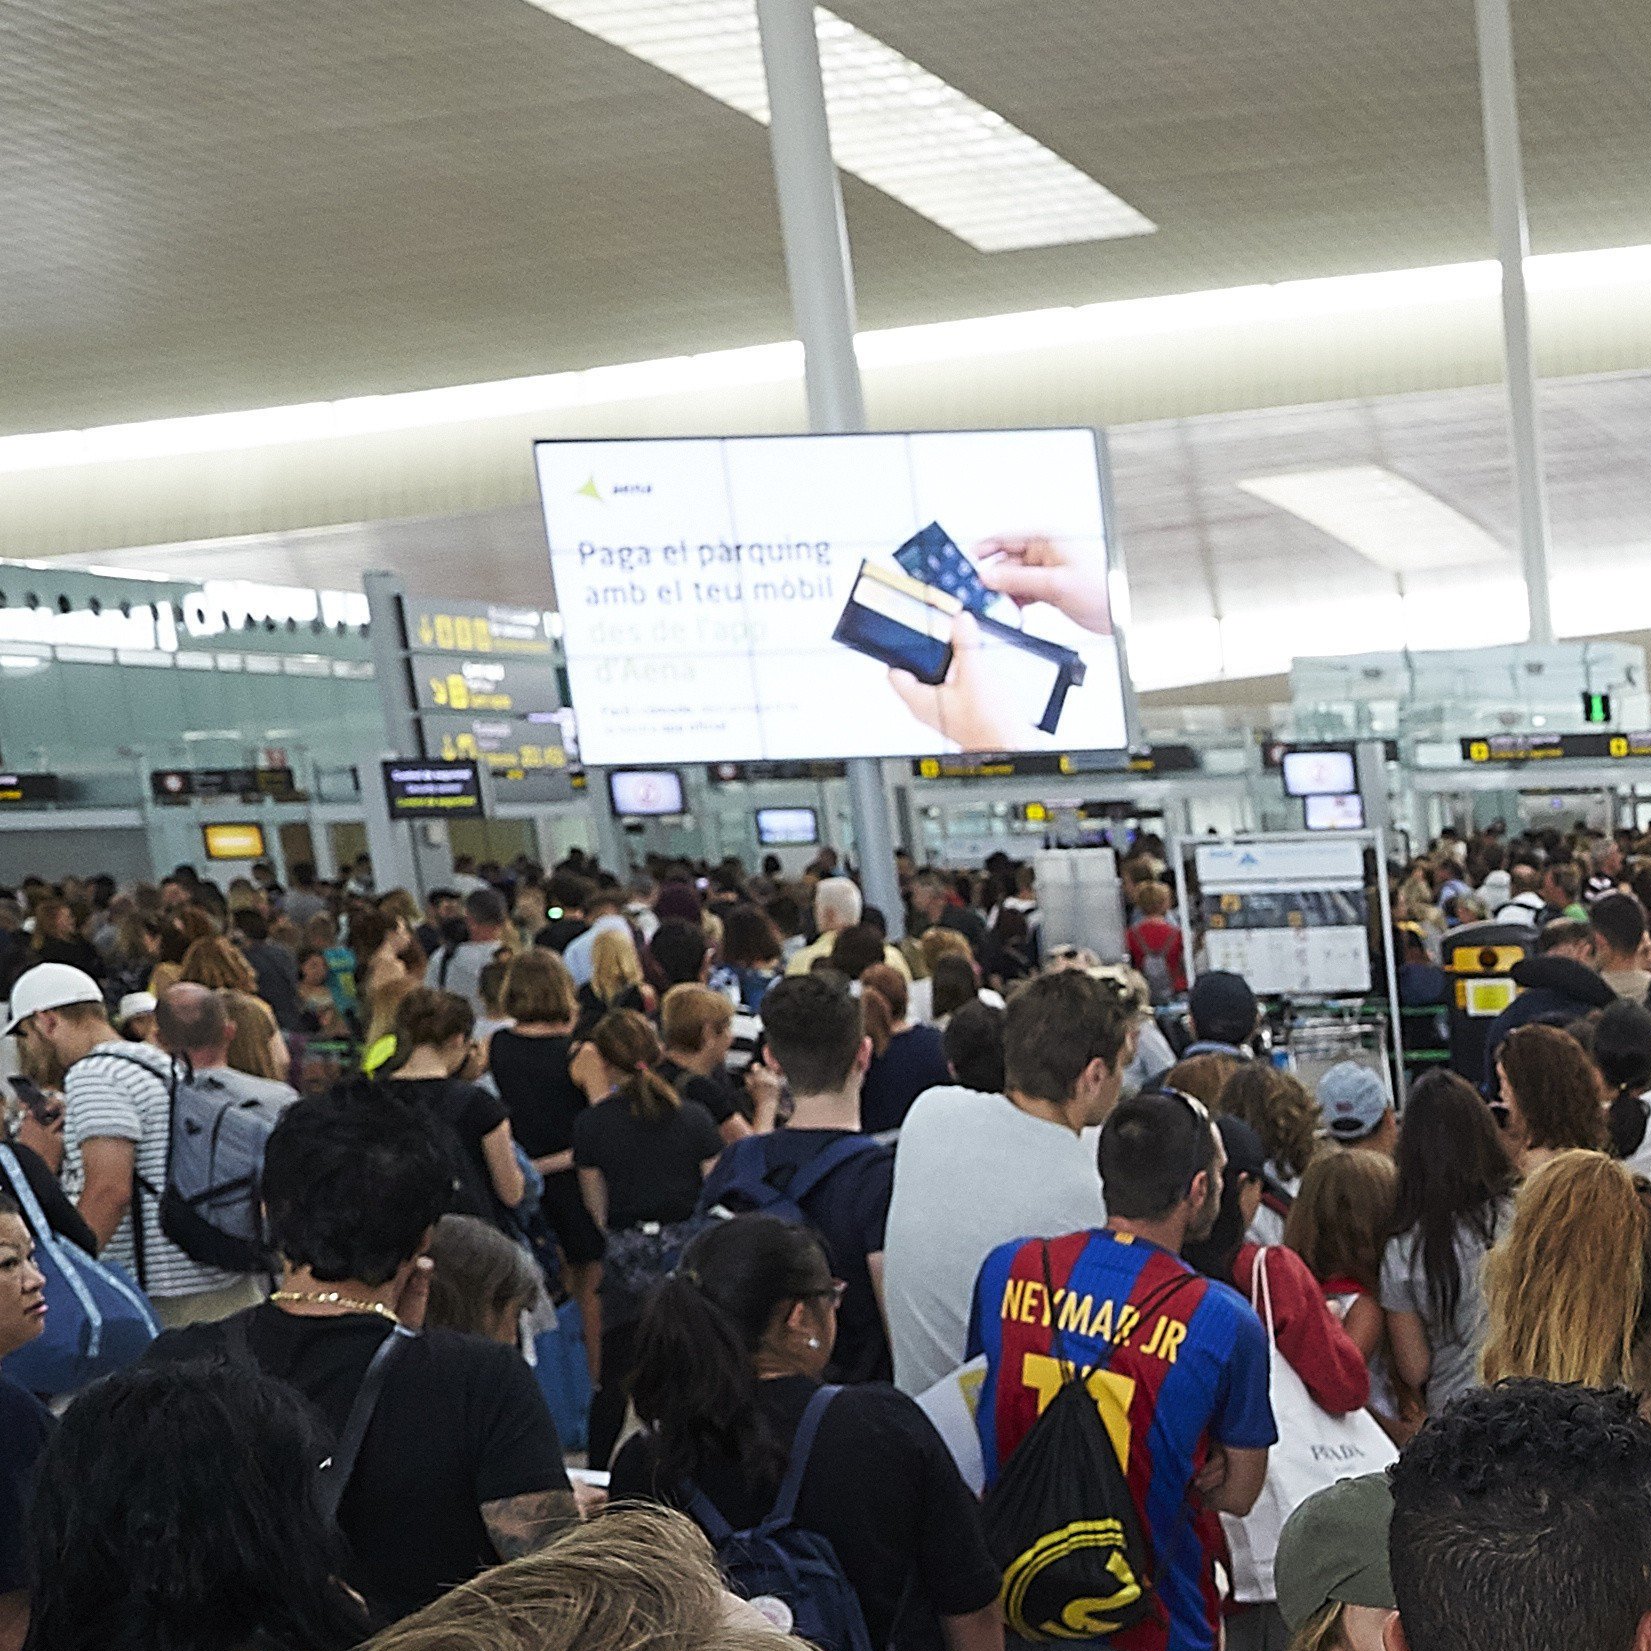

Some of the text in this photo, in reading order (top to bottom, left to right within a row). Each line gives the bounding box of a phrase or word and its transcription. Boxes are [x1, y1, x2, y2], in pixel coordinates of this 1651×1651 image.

[578, 535, 832, 572] Paga el pàrquing
[585, 573, 833, 606] amb el teu mòbil
[1001, 1277, 1188, 1365] NEYMAR JR
